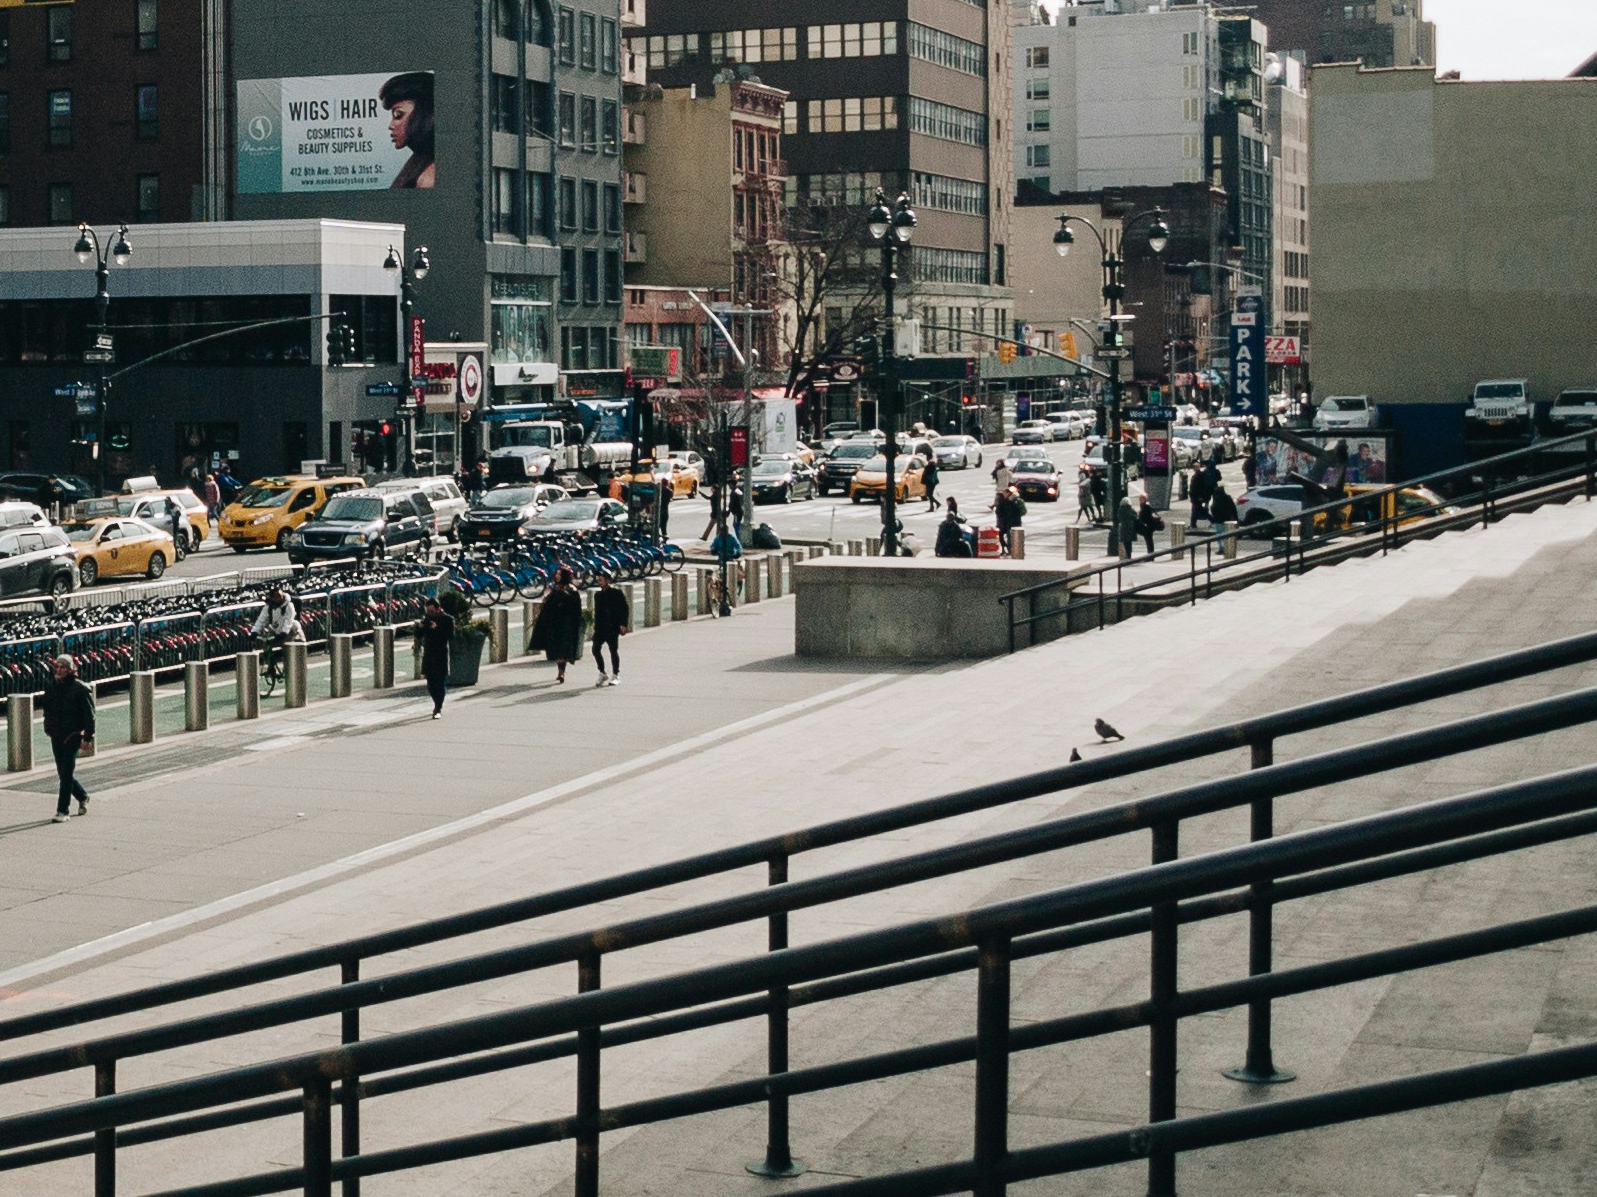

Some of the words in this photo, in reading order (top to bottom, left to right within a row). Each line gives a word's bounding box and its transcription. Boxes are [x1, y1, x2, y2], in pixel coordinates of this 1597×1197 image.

[289, 101, 329, 121] WIGS
[340, 99, 378, 119] HAIR
[306, 128, 355, 140] COSMETICS
[357, 127, 364, 138] &
[298, 143, 329, 155] BEAUTY
[332, 141, 373, 154] SUPPLIES
[290, 167, 302, 176] 412
[413, 319, 421, 353] PANDA
[1236, 328, 1252, 395] PARK
[1129, 410, 1147, 418] West
[1164, 410, 1173, 418] St
